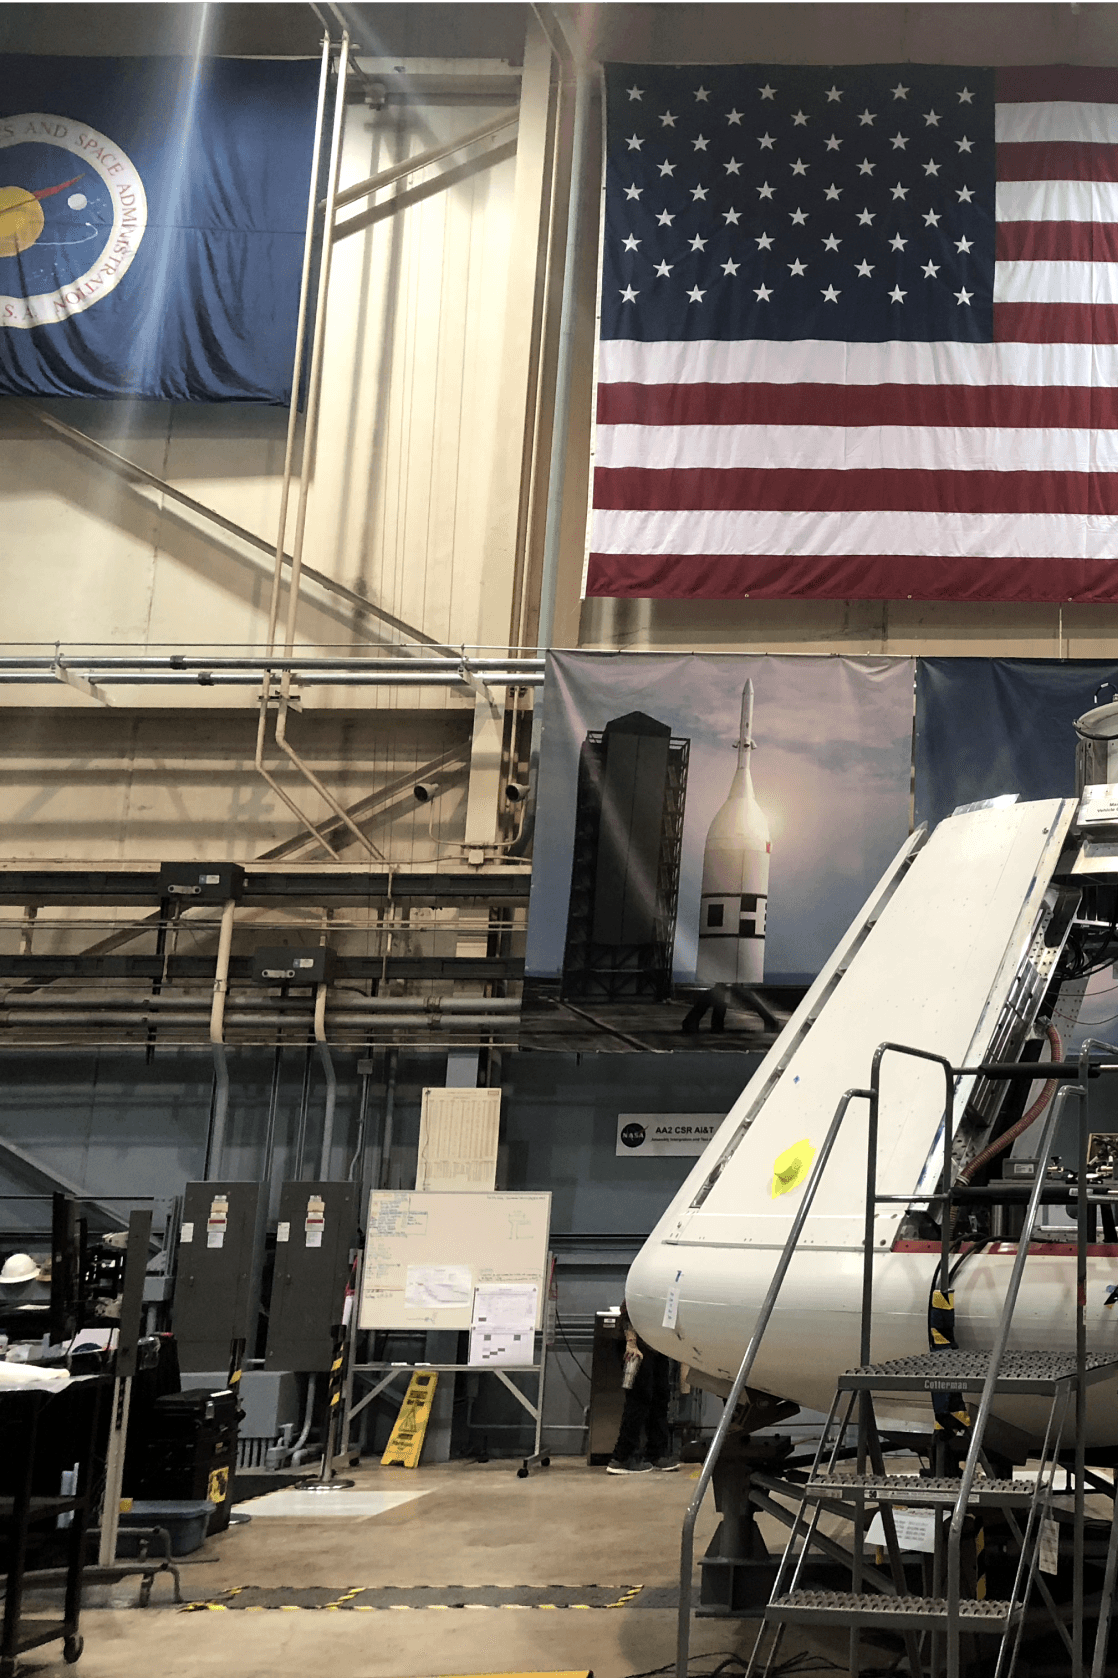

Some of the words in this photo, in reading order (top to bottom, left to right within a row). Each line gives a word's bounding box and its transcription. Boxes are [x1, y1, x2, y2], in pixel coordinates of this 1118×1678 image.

[27, 121, 68, 139] AND
[77, 133, 124, 177] SPACE
[54, 184, 138, 320] ADMINISTRATION
[655, 1126, 673, 1134] AA2
[674, 1126, 693, 1134] CSR
[924, 1380, 968, 1390] Cotterman
